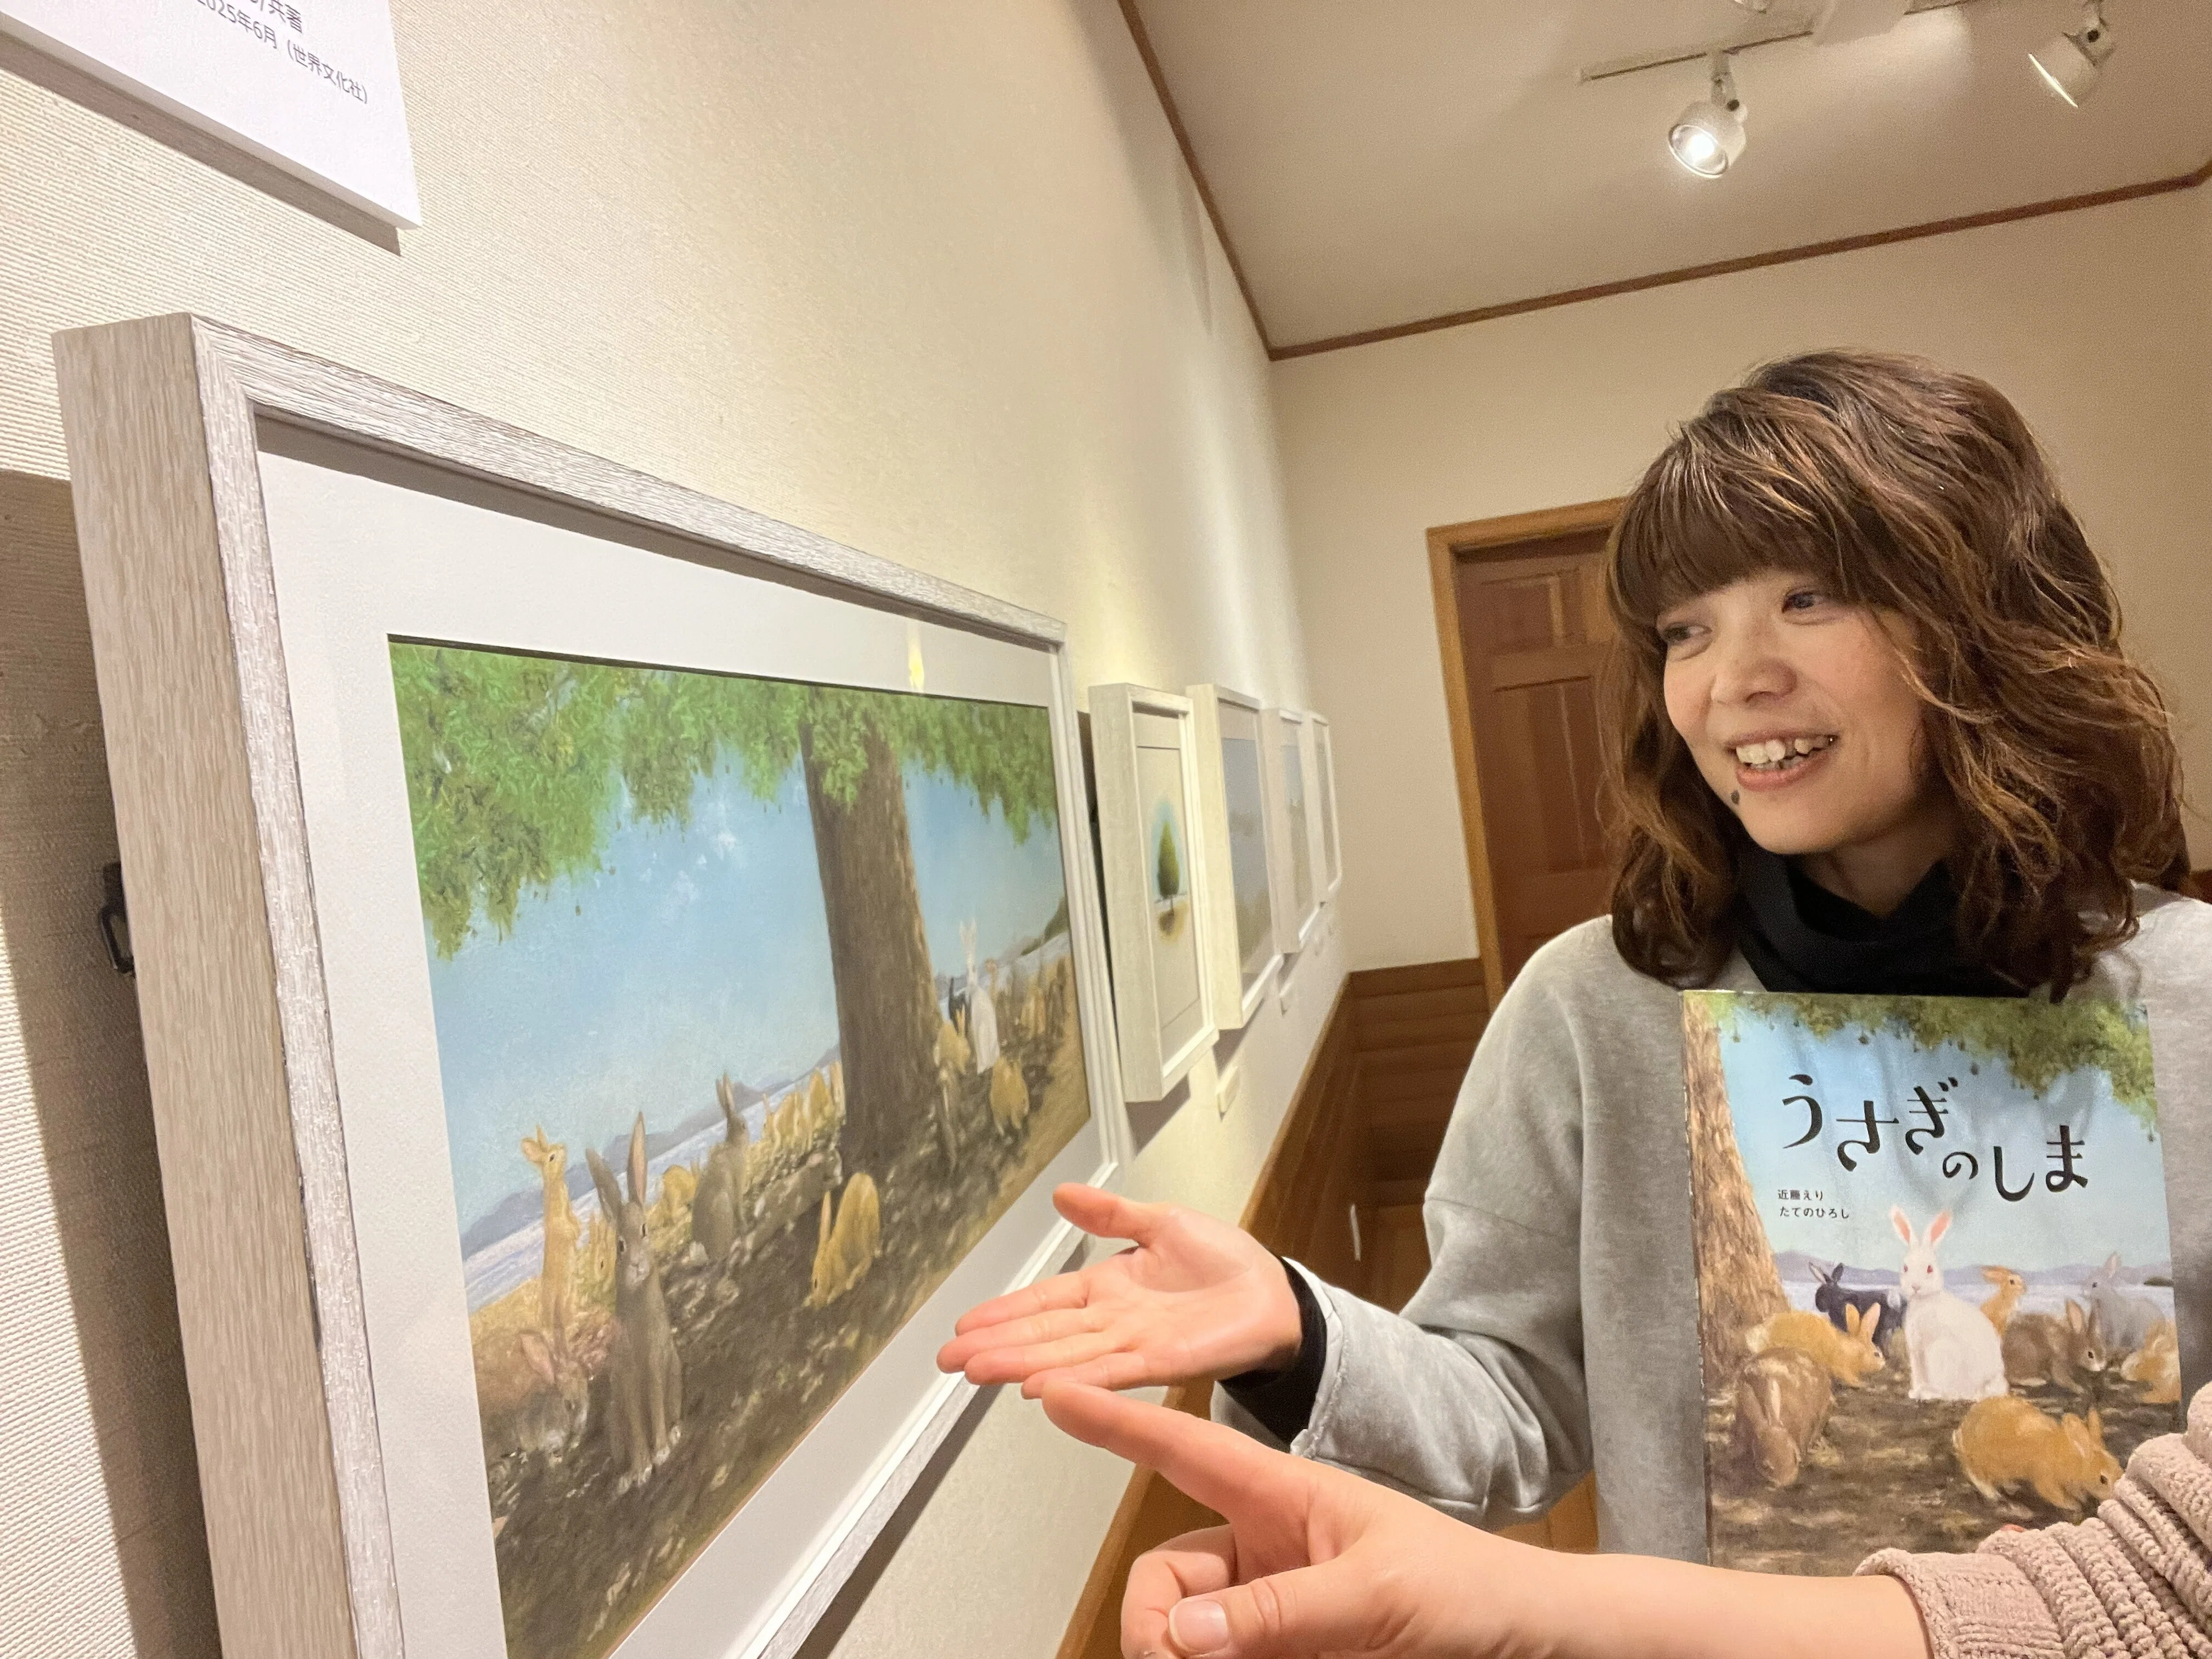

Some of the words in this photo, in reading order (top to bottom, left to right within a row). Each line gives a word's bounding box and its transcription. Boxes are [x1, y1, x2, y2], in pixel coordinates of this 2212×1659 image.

[1782, 1074, 2089, 1203] うさぎのしま
[1778, 1189, 1823, 1201] 近藤えり
[1780, 1206, 1849, 1219] たてのひろし
